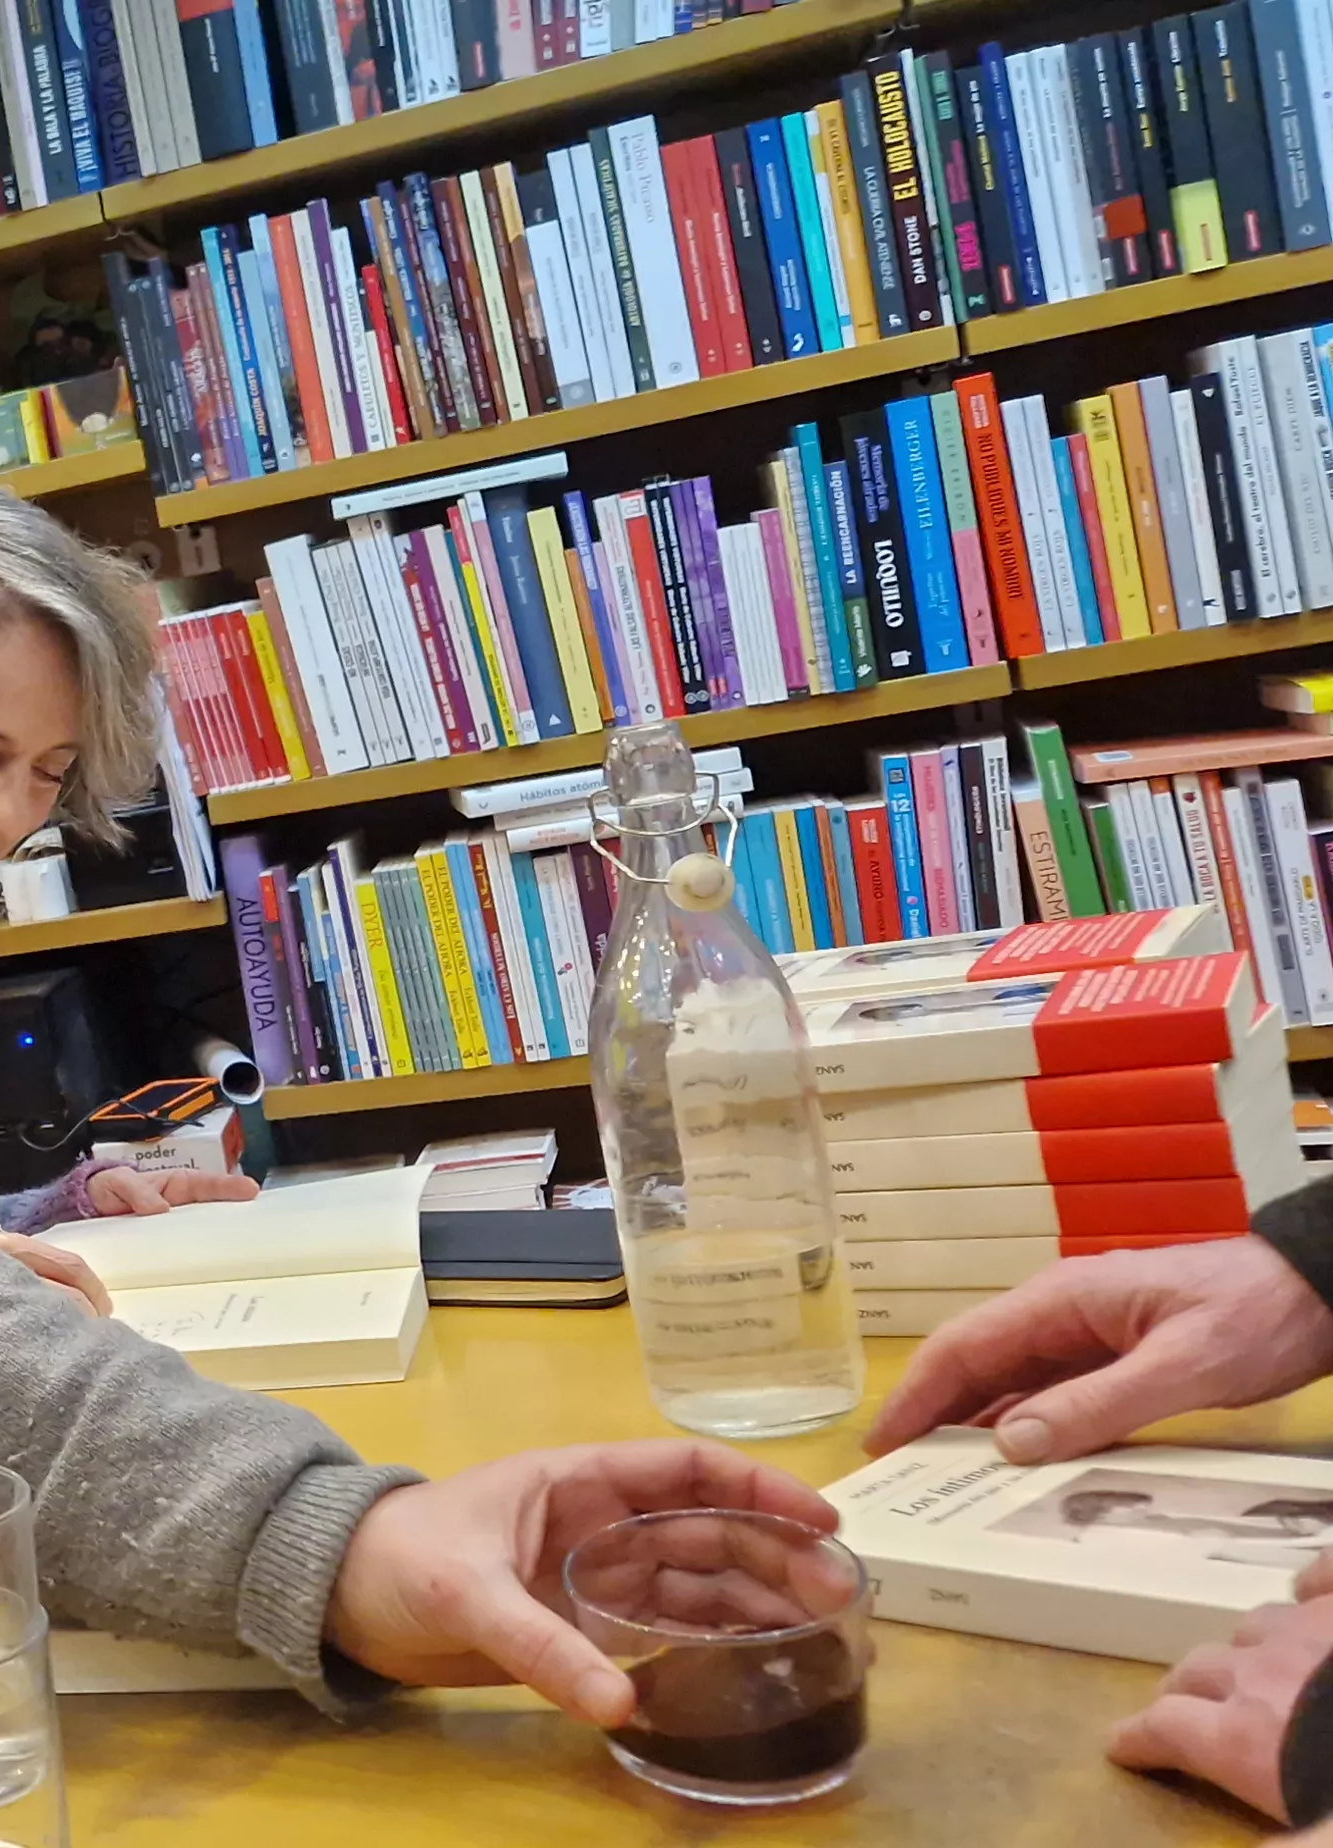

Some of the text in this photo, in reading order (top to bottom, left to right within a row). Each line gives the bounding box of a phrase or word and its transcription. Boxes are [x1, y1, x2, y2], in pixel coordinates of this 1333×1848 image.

[32, 44, 63, 155] LA BALA Y LA PALABRA
[70, 119, 91, 137] EL
[628, 131, 651, 172] Pablo
[874, 70, 928, 285] DAN STONE EL HOLOCAUSTO
[606, 212, 630, 268] BATURRADAS
[620, 279, 642, 327] ANTOLOGÍA
[246, 367, 260, 397] COSTA
[1225, 355, 1245, 417] Rafael Yuste
[1237, 425, 1252, 461] mundo
[903, 418, 934, 529] EILENBERGER
[976, 432, 996, 453] NO
[994, 529, 1014, 548] MI
[826, 469, 857, 584] LA REENCARNACIÓN
[873, 538, 906, 629] LOQUILLO
[519, 779, 602, 802] Hábitos atóm
[890, 799, 912, 813] 12
[1184, 808, 1203, 839] SALUD
[1191, 840, 1206, 853] TU
[867, 859, 884, 900] AYUNO
[1196, 862, 1214, 888] BOCA
[360, 902, 384, 950] DYER
[418, 868, 454, 978] EL PODER DEL AHORA
[434, 865, 470, 975] EL PODER DEL AHORA
[236, 896, 278, 1032] AUTOAYUDA
[815, 1064, 845, 1075] SANZ
[823, 1111, 846, 1121] SAN
[832, 1162, 855, 1172] SAN
[849, 1260, 875, 1271] SAN
[889, 1494, 940, 1517] Los
